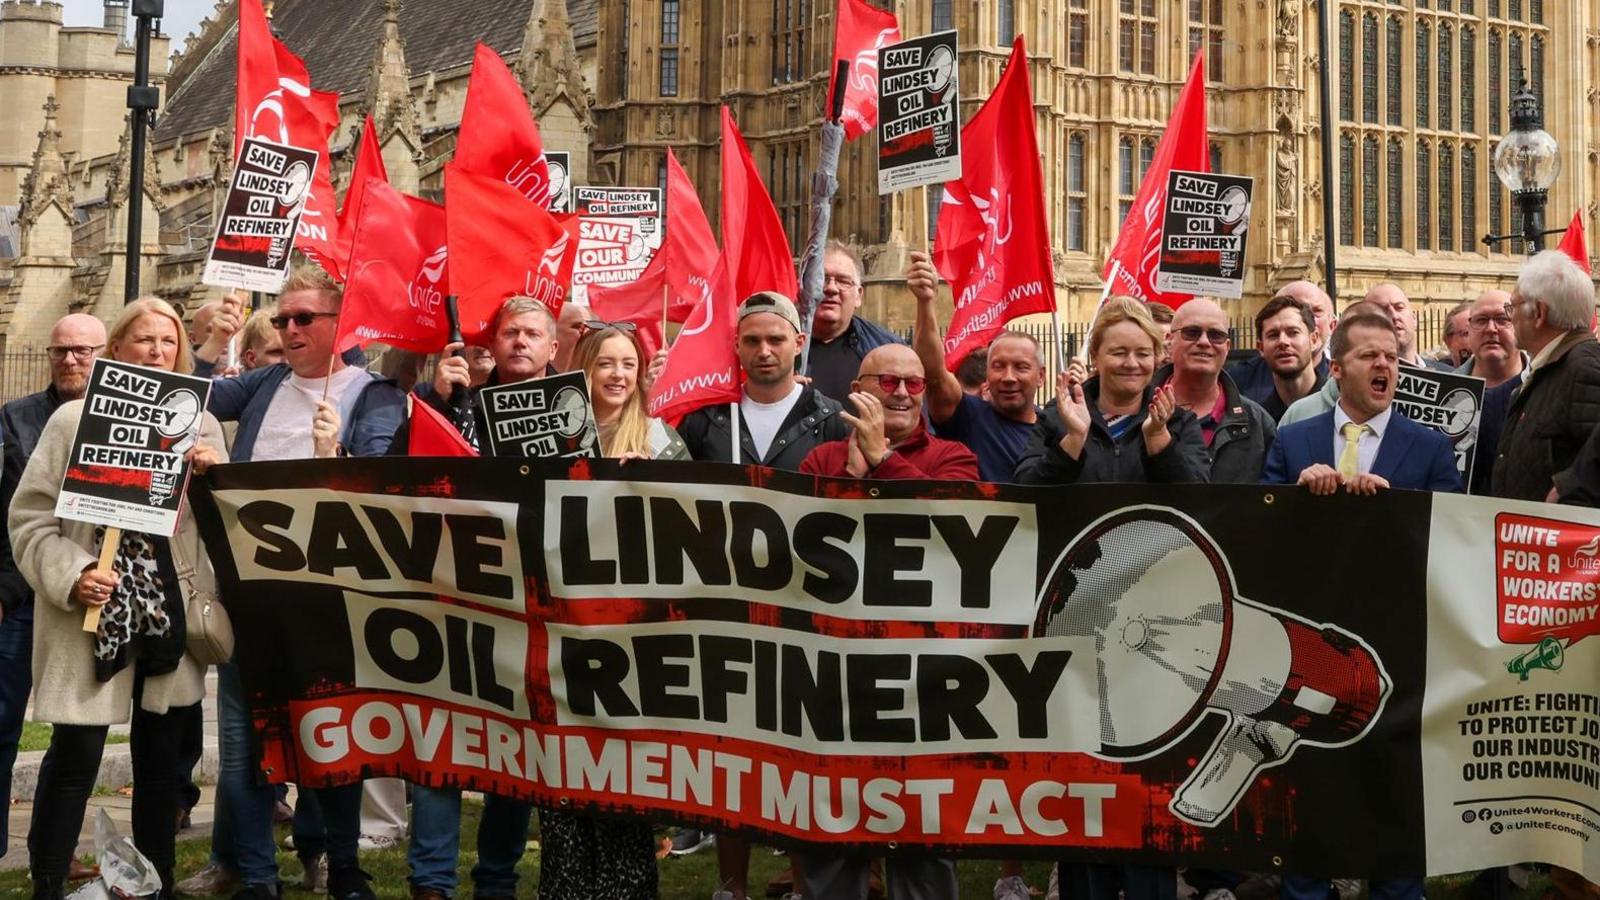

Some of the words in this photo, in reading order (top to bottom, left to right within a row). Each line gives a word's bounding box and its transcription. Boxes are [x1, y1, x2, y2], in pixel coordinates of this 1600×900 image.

[886, 50, 920, 67] SAVE
[884, 68, 940, 94] LINDSEY
[900, 94, 922, 112] OIL
[886, 106, 948, 140] REFINERY
[250, 148, 284, 171] SAVE
[239, 174, 294, 196] LINDSEY
[580, 190, 606, 200] SAVE
[610, 192, 649, 201] LINDSEY
[1178, 178, 1216, 196] SAVE
[250, 200, 270, 213] OIL
[590, 205, 606, 213] OIL
[610, 203, 654, 213] REFINERY
[1173, 199, 1233, 216] LINDSEY
[228, 219, 290, 235] REFINERY
[580, 222, 631, 242] SAVE
[1189, 220, 1212, 232] OIL
[1170, 237, 1238, 249] REFINERY
[581, 249, 624, 266] OUR
[574, 269, 643, 283] COMMUNI
[104, 370, 157, 398] SAVE
[496, 392, 543, 409] SAVE
[93, 398, 178, 426] LINDSEY
[1392, 402, 1458, 425] INDSEY
[112, 427, 144, 444] OIL
[498, 412, 570, 439] LINDSEY
[82, 447, 179, 471] REFINERY
[526, 440, 555, 457] OIL
[1501, 523, 1560, 547] UNITE
[236, 500, 514, 600] SAVE
[560, 495, 1020, 609] LINDSEY
[1503, 550, 1540, 572] FOR
[1547, 554, 1560, 574] A
[1504, 604, 1599, 626] ECONOMY
[364, 607, 514, 711] OIL
[560, 634, 1072, 744] REFINERY
[1467, 695, 1530, 716] UNITE:
[1536, 693, 1600, 716] FIGHTI
[1458, 718, 1483, 735] TO
[1488, 716, 1576, 734] PROTECT
[1580, 719, 1600, 741] JO
[1473, 740, 1512, 758] OUR
[1518, 738, 1600, 765] INDUSTR
[300, 701, 752, 812] GOVERNMENT
[761, 763, 953, 837] MUST
[965, 779, 1117, 838] ACT
[1463, 762, 1503, 781] OUR
[1508, 761, 1599, 790] COMMUNI
